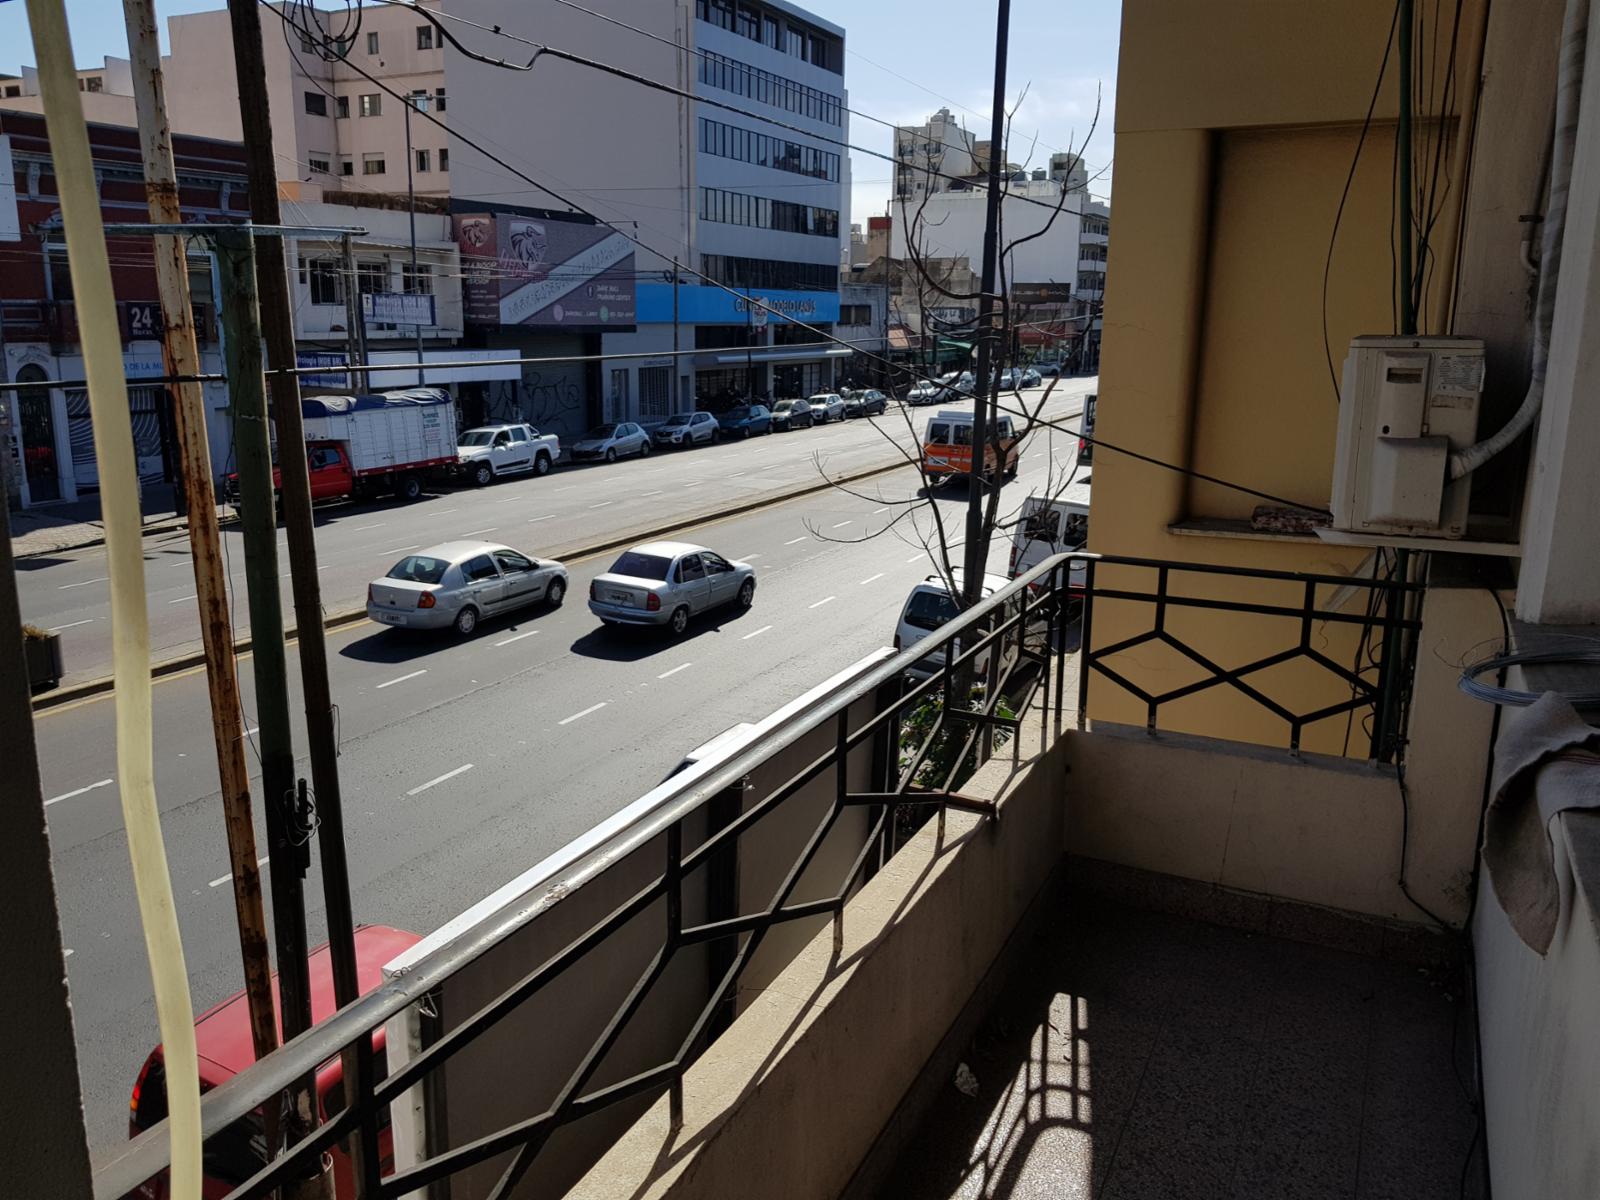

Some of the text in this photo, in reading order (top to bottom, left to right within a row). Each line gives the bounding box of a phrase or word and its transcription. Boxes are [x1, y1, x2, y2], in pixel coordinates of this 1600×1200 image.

[131, 307, 152, 328] 24
[129, 362, 139, 370] DE
[141, 362, 150, 370] LA
